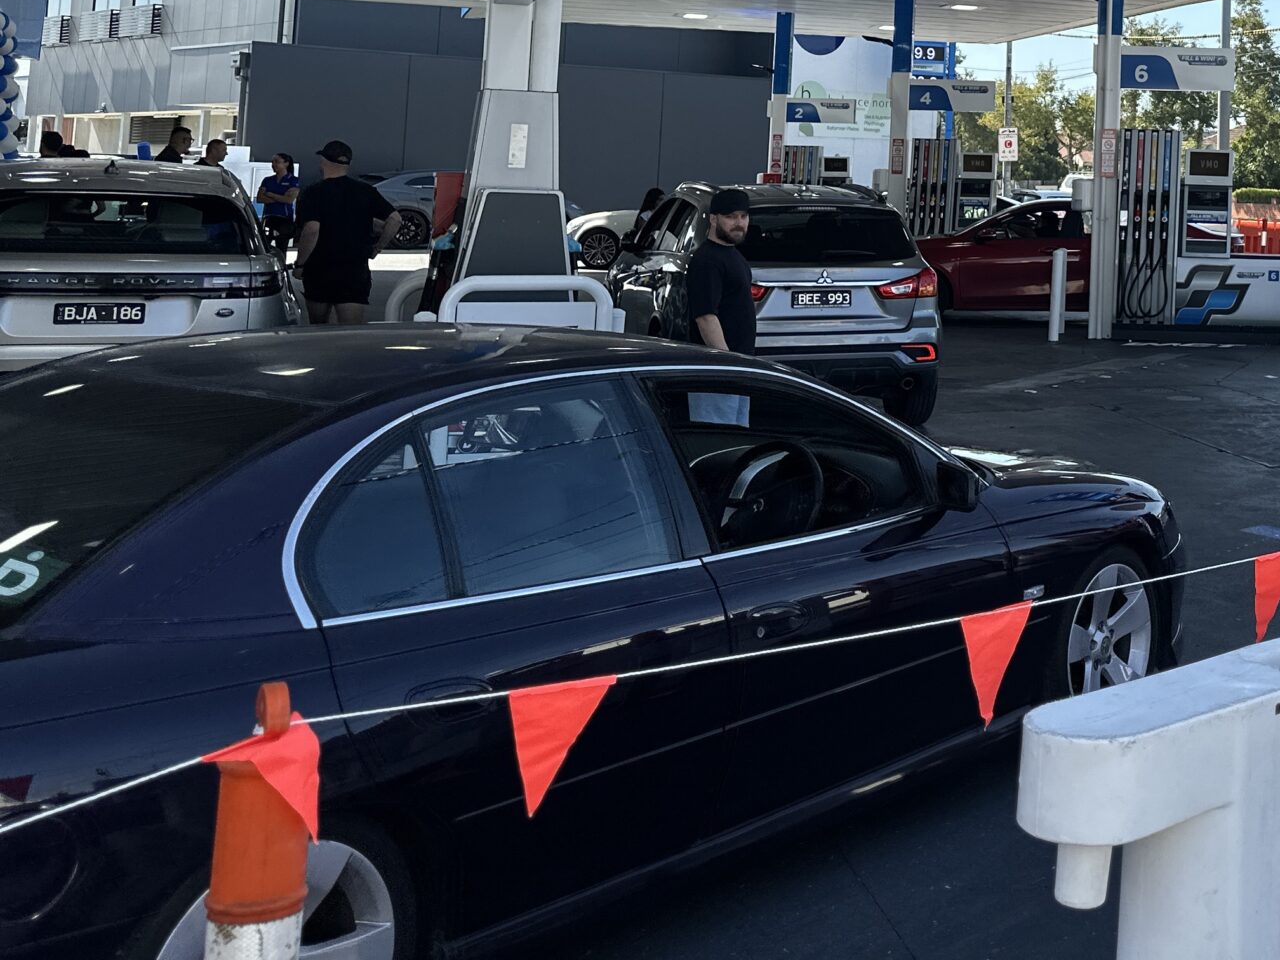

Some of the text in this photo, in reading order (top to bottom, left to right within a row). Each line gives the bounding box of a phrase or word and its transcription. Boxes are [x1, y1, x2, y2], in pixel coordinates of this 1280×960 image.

[1134, 64, 1149, 83] 6
[920, 91, 932, 105] 4
[794, 108, 804, 119] 2
[1270, 272, 1277, 280] 6
